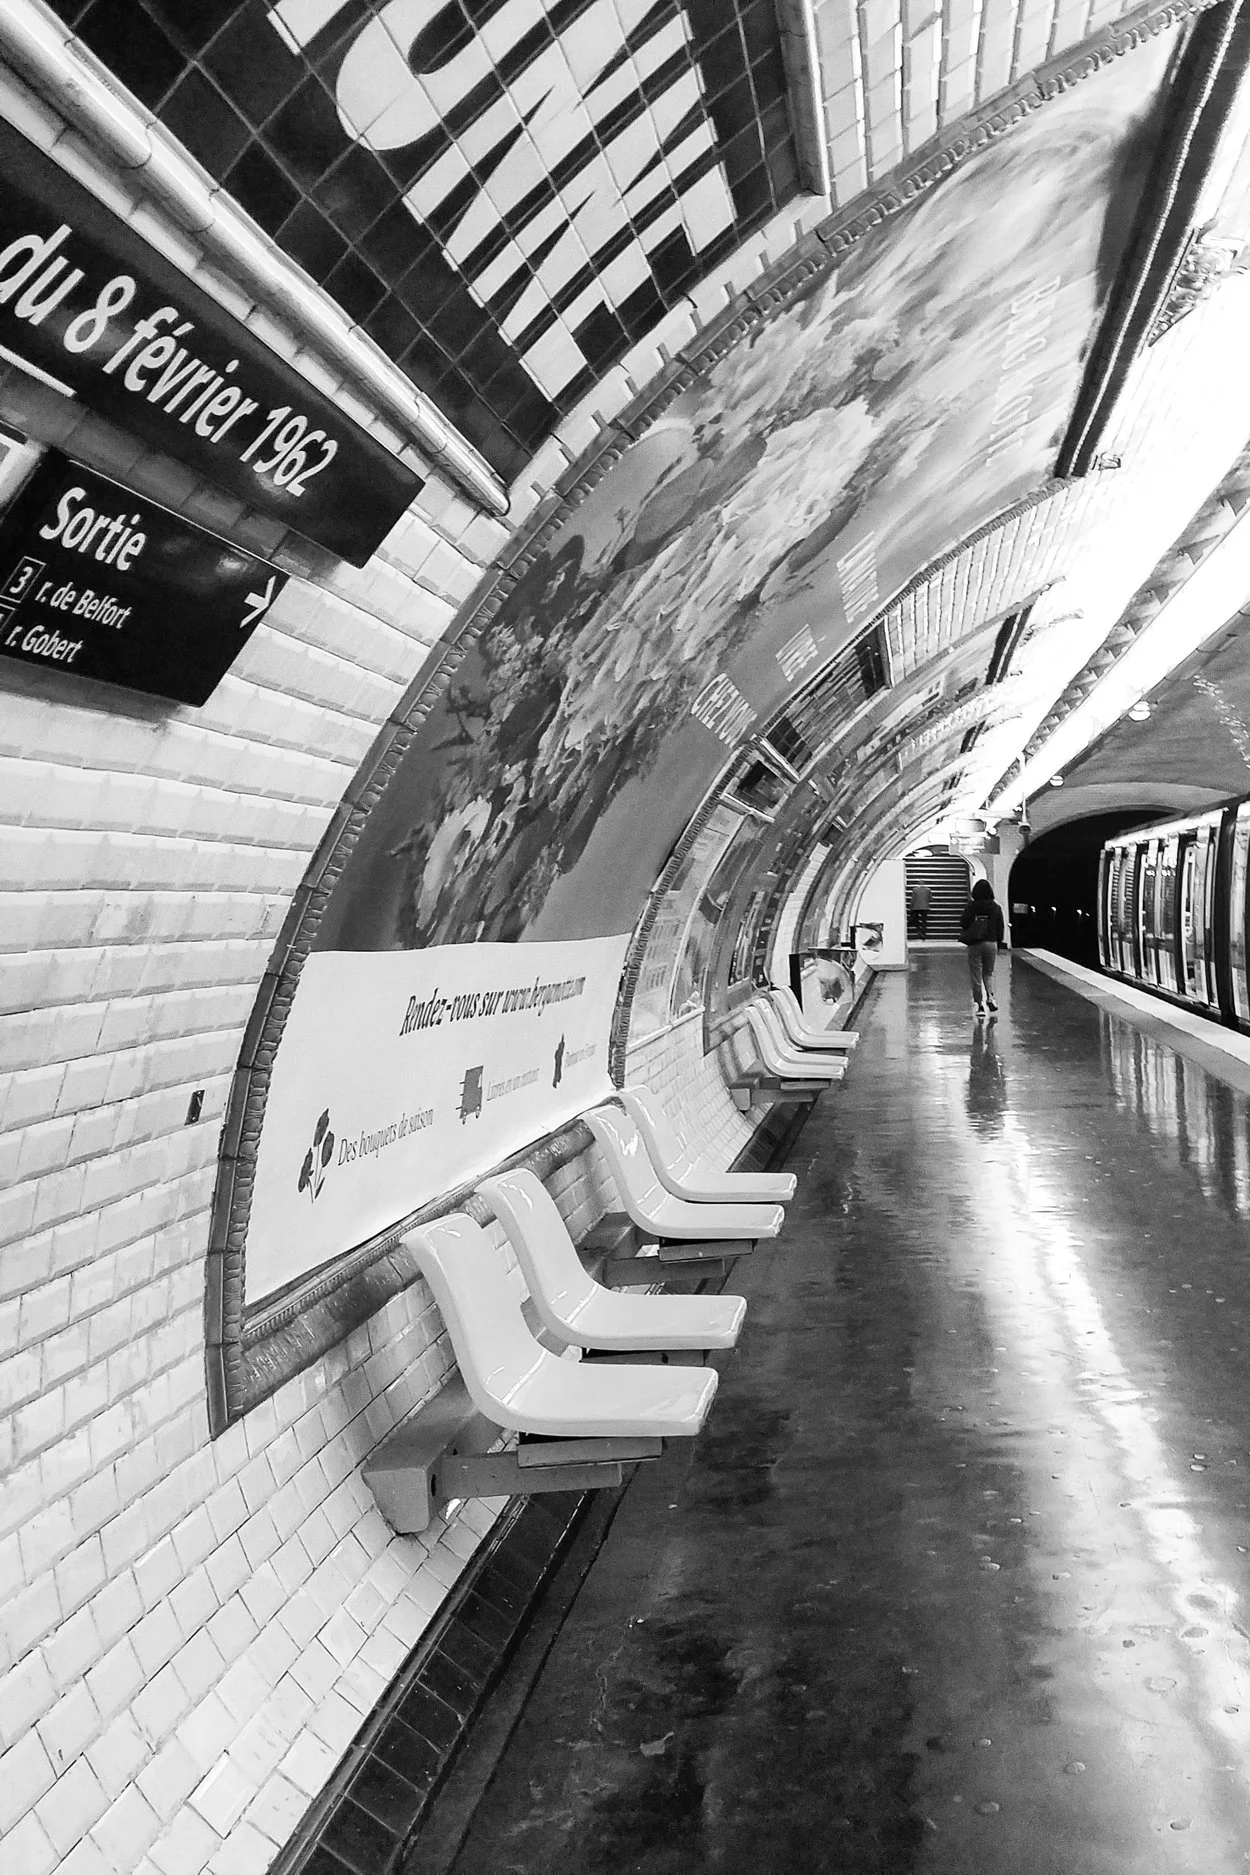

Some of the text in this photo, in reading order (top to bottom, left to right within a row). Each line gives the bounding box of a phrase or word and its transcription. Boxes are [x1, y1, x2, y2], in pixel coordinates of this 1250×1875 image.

[267, 0, 738, 402] ONNE
[0, 224, 339, 497] du 8 février 1962
[39, 486, 148, 571] Sortie
[9, 566, 133, 629] 3 r. de Belfort
[4, 624, 84, 664] r. Gobert
[691, 673, 740, 730] CHEZ
[399, 987, 481, 1037] Rendez-vous
[478, 991, 504, 1017] sur
[338, 1107, 434, 1166] Des bouquets de saison
